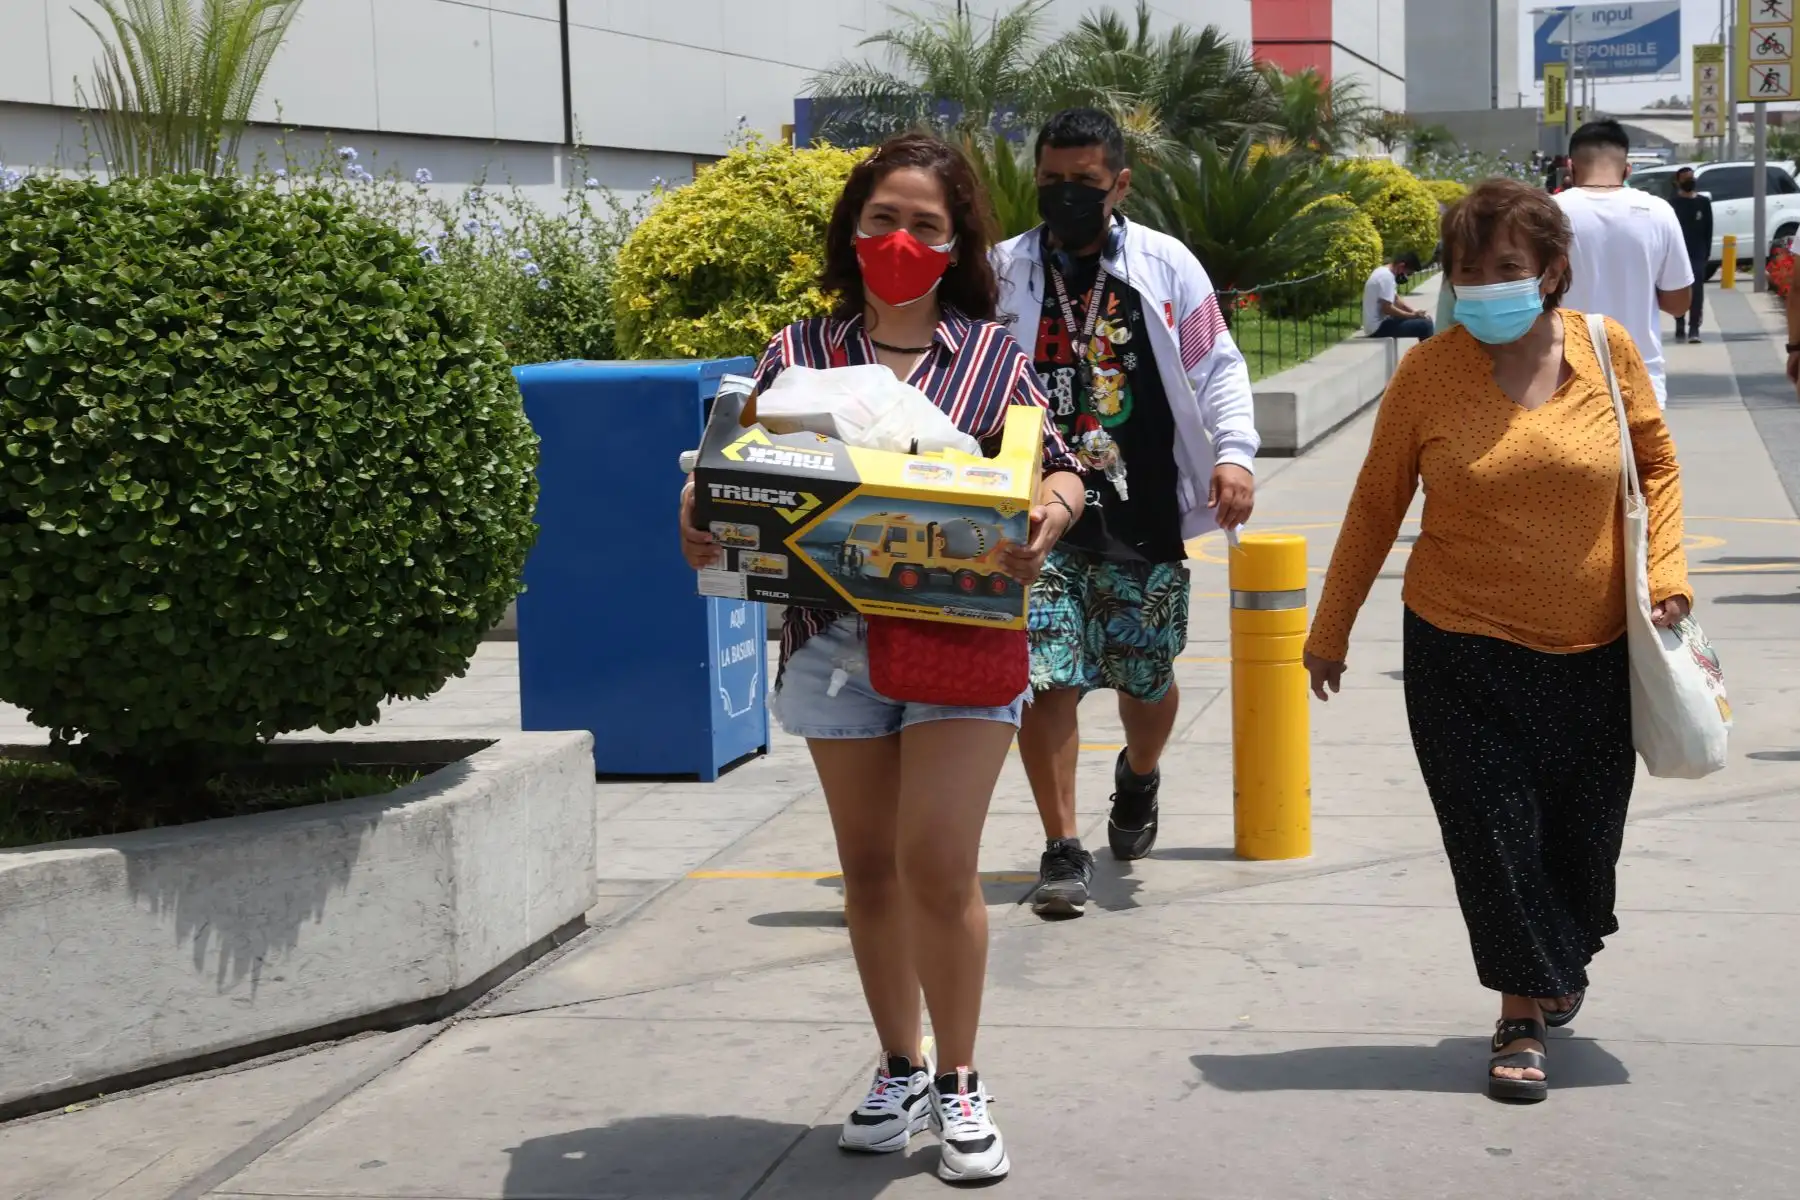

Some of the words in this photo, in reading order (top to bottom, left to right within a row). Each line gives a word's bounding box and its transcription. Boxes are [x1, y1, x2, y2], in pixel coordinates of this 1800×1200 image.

[1592, 5, 1633, 25] input
[746, 446, 836, 471] TRUCK
[708, 483, 797, 506] TRUCK
[754, 589, 790, 599] TRUCK
[721, 648, 731, 668] LA
[731, 639, 755, 664] BASURA
